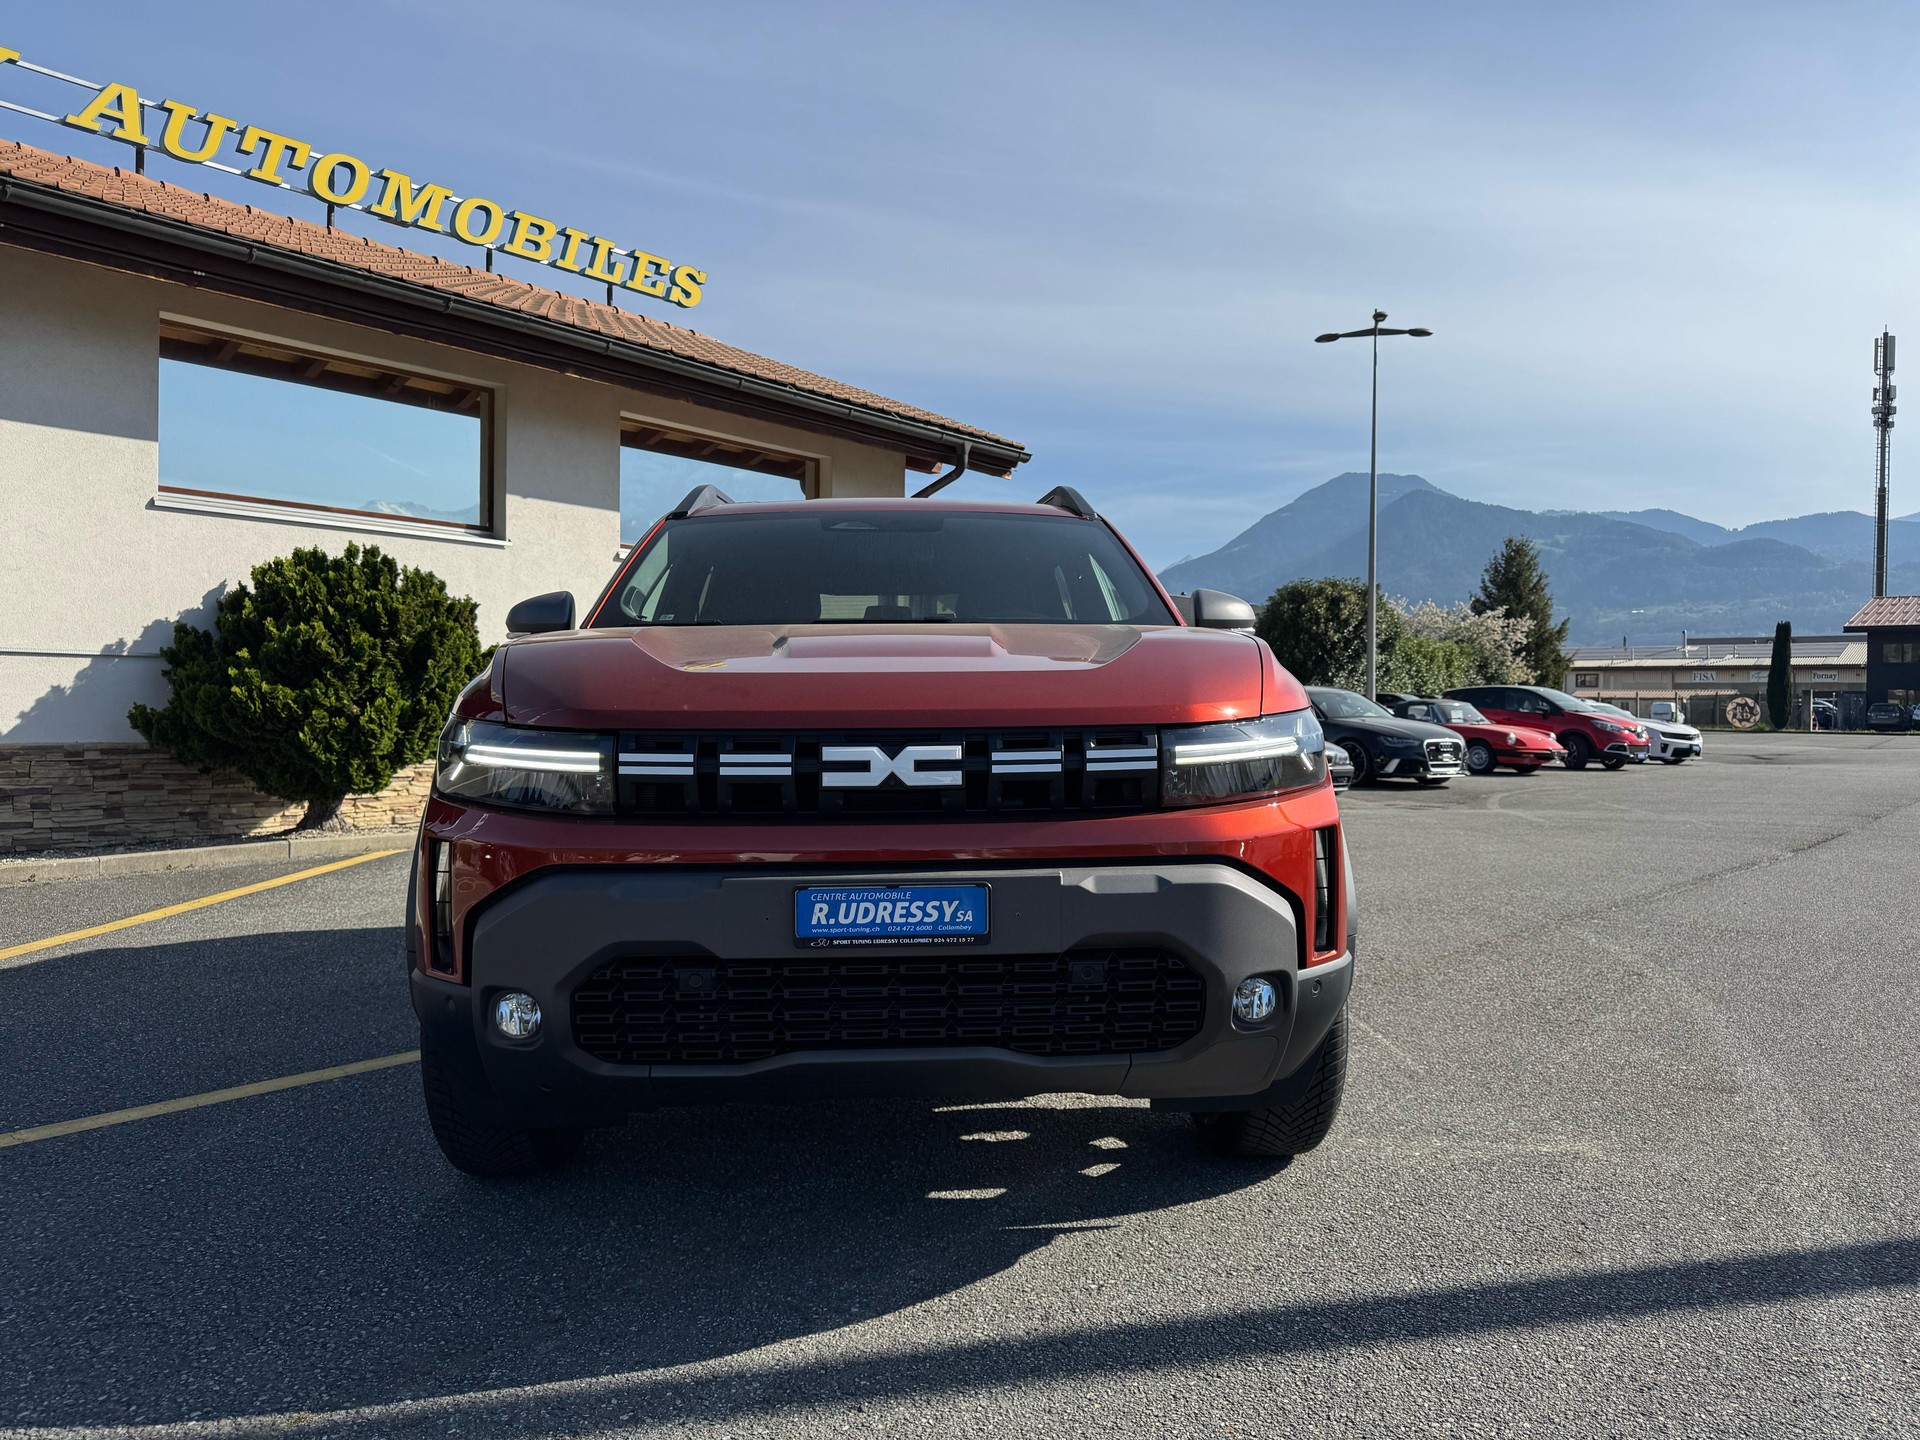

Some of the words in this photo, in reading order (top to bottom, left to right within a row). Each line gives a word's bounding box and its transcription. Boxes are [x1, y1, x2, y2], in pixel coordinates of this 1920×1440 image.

[63, 82, 707, 308] AUTOMOBILES
[1693, 672, 1715, 681] FISA
[1813, 672, 1838, 681] Fornay
[811, 893, 847, 901] CENTRE
[849, 891, 912, 900] AUTOMOBILE
[811, 900, 960, 925] R.UDRESSY
[956, 910, 973, 922] SA
[811, 926, 880, 934] www.sport-tuning.ch
